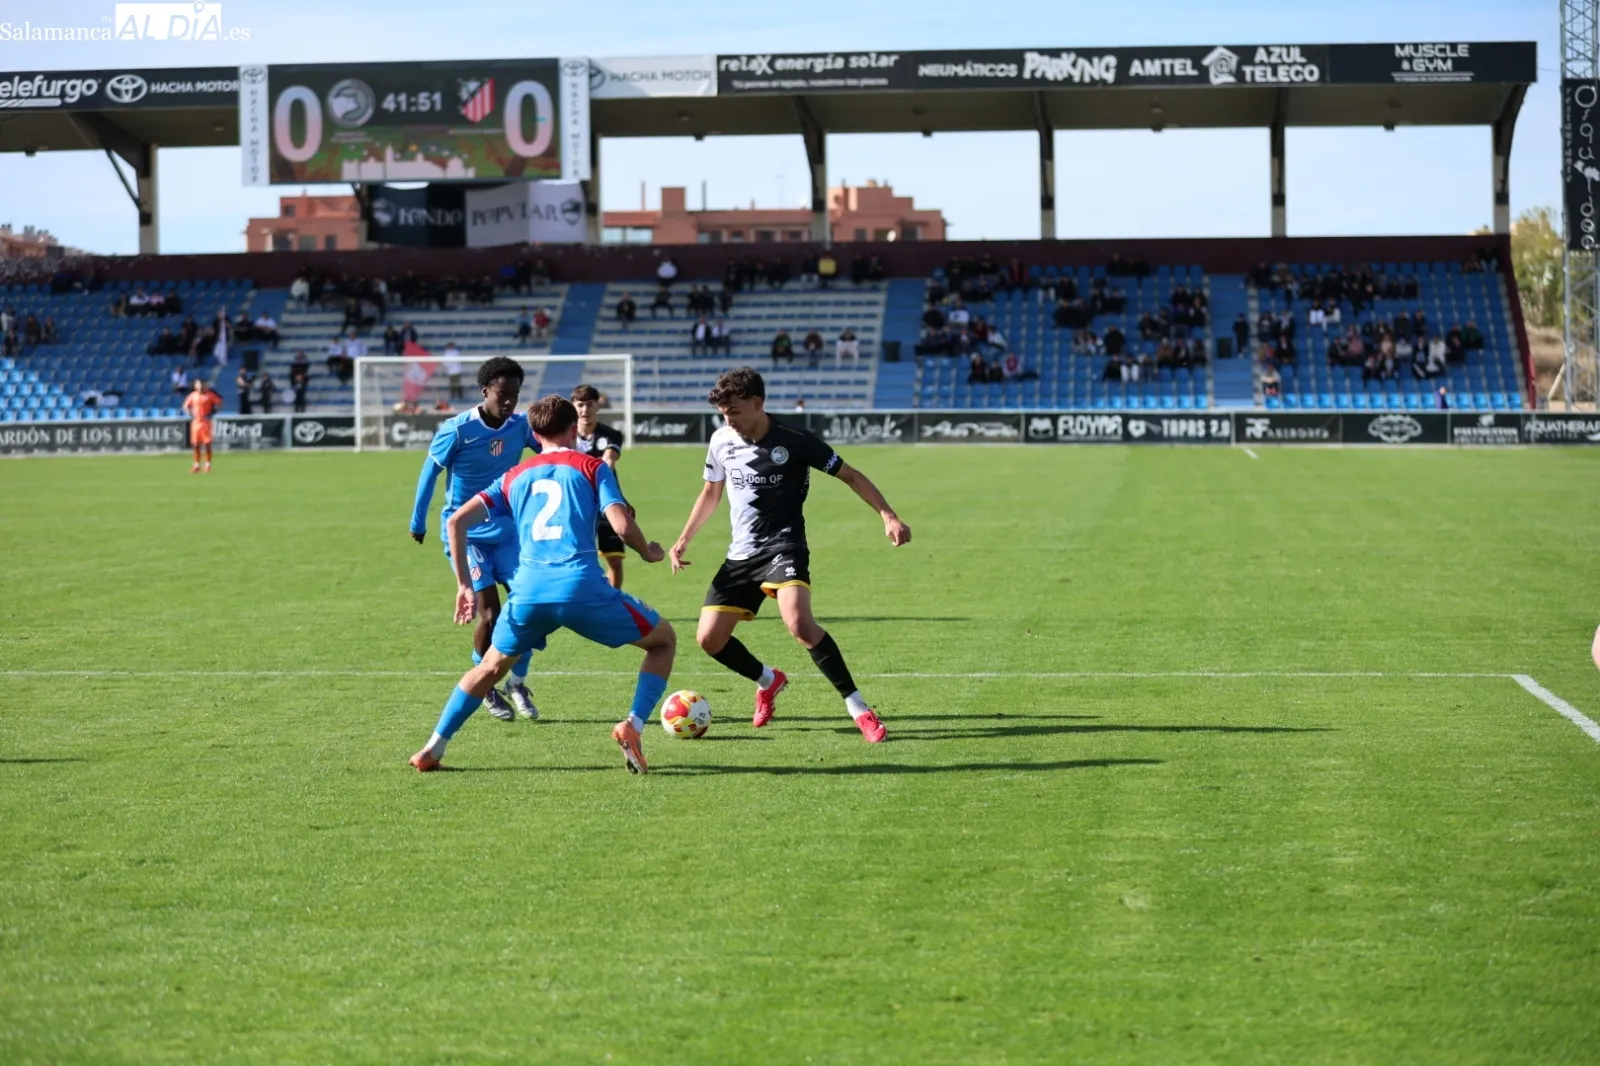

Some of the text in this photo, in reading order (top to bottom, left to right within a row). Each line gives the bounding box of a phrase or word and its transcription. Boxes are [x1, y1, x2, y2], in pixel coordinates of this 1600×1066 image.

[1254, 46, 1307, 64] AZUL
[1394, 44, 1470, 58] MUSCLE
[774, 54, 845, 73] energía
[848, 52, 899, 68] solar
[917, 61, 1018, 78] NEUMÁTICOS
[1129, 59, 1199, 77] AMTEL
[1412, 59, 1453, 72] GYM
[611, 69, 712, 83] HACHA MOTOR
[1242, 64, 1320, 83] TELECO
[151, 80, 240, 93] HACHA MOTOR
[380, 91, 442, 113] 41:51
[274, 85, 322, 162] 0
[505, 80, 554, 157] 0
[55, 428, 76, 445] DE
[81, 427, 112, 444] LOS
[116, 424, 183, 443] FRAILES
[1161, 419, 1207, 438] TAPAS
[747, 473, 767, 485] Don
[531, 478, 564, 542] 2
